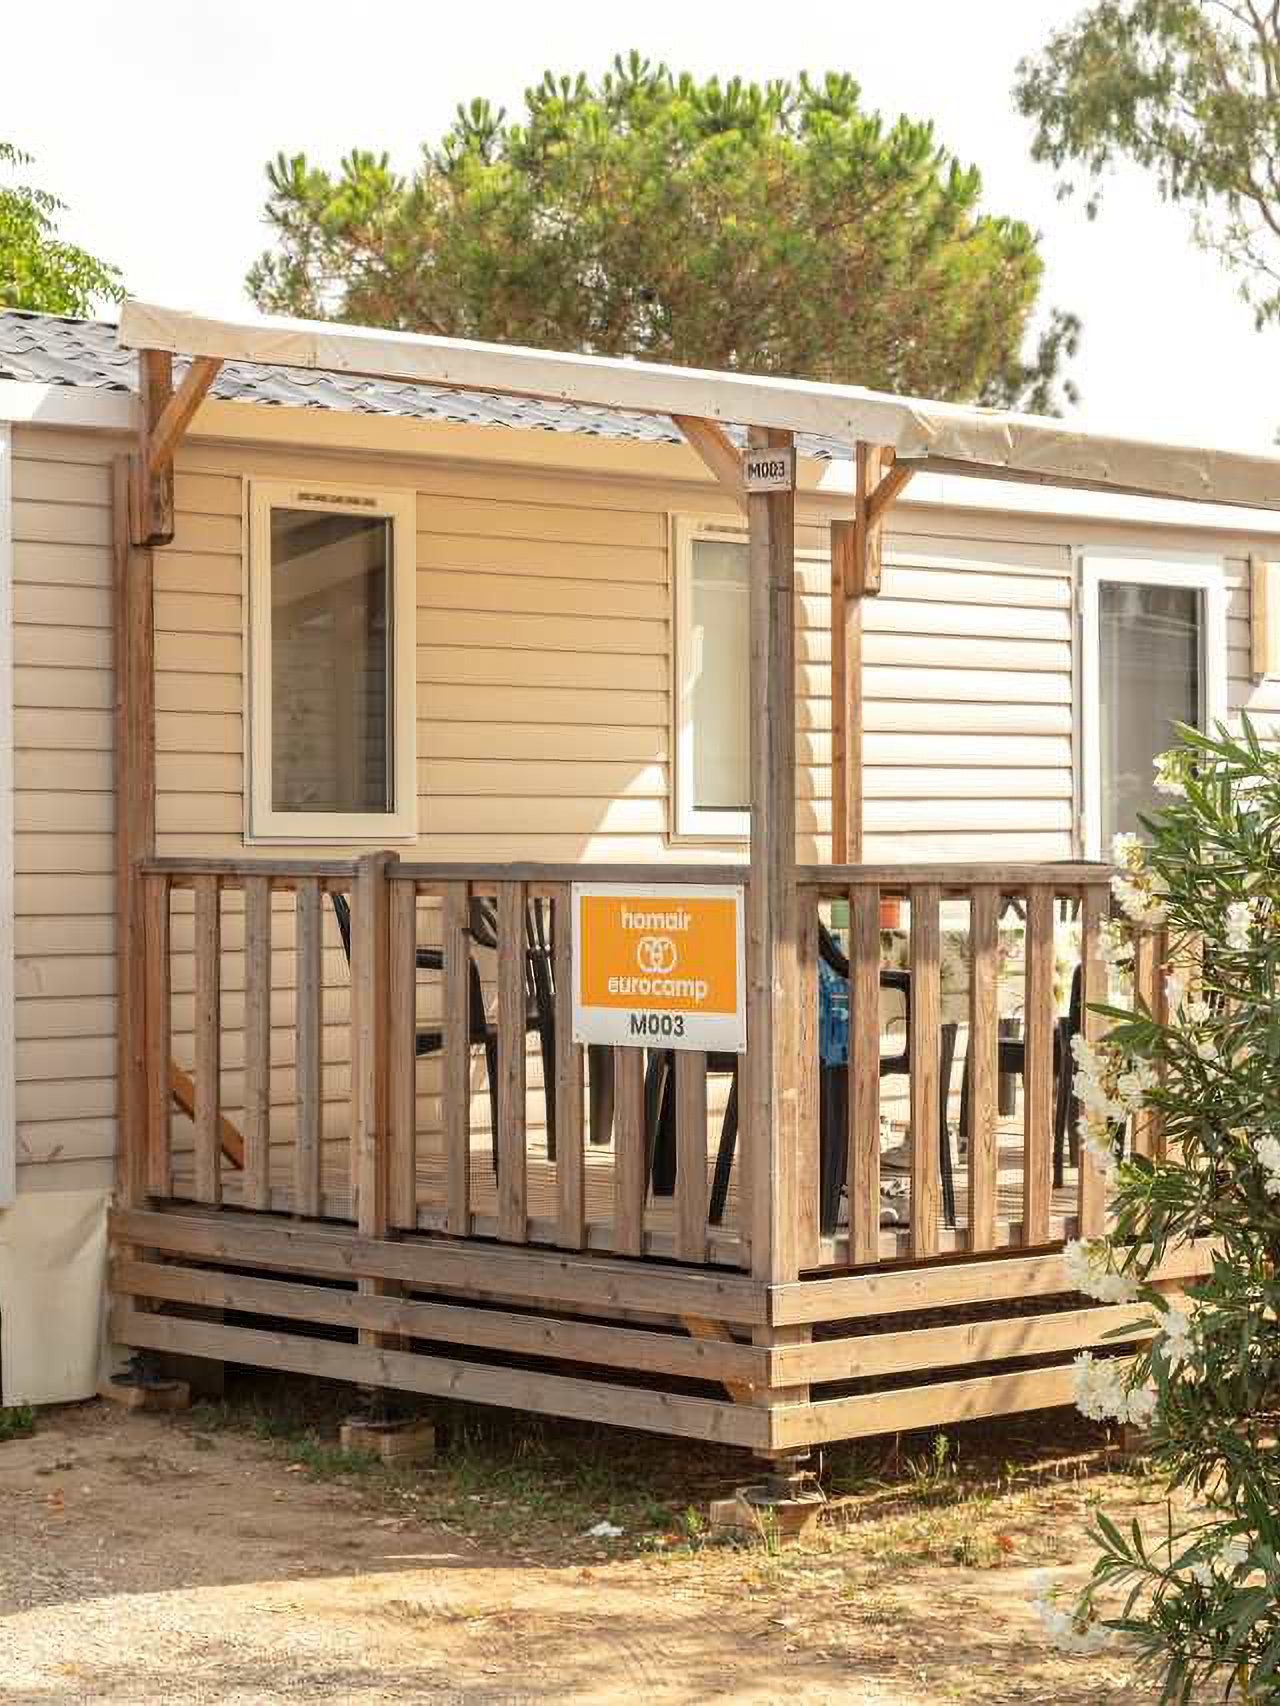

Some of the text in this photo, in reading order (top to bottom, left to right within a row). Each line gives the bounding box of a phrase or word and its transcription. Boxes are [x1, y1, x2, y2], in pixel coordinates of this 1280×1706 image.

[621, 905, 690, 929] homair
[608, 977, 708, 1004] eurocamp
[630, 1013, 685, 1036] M003
